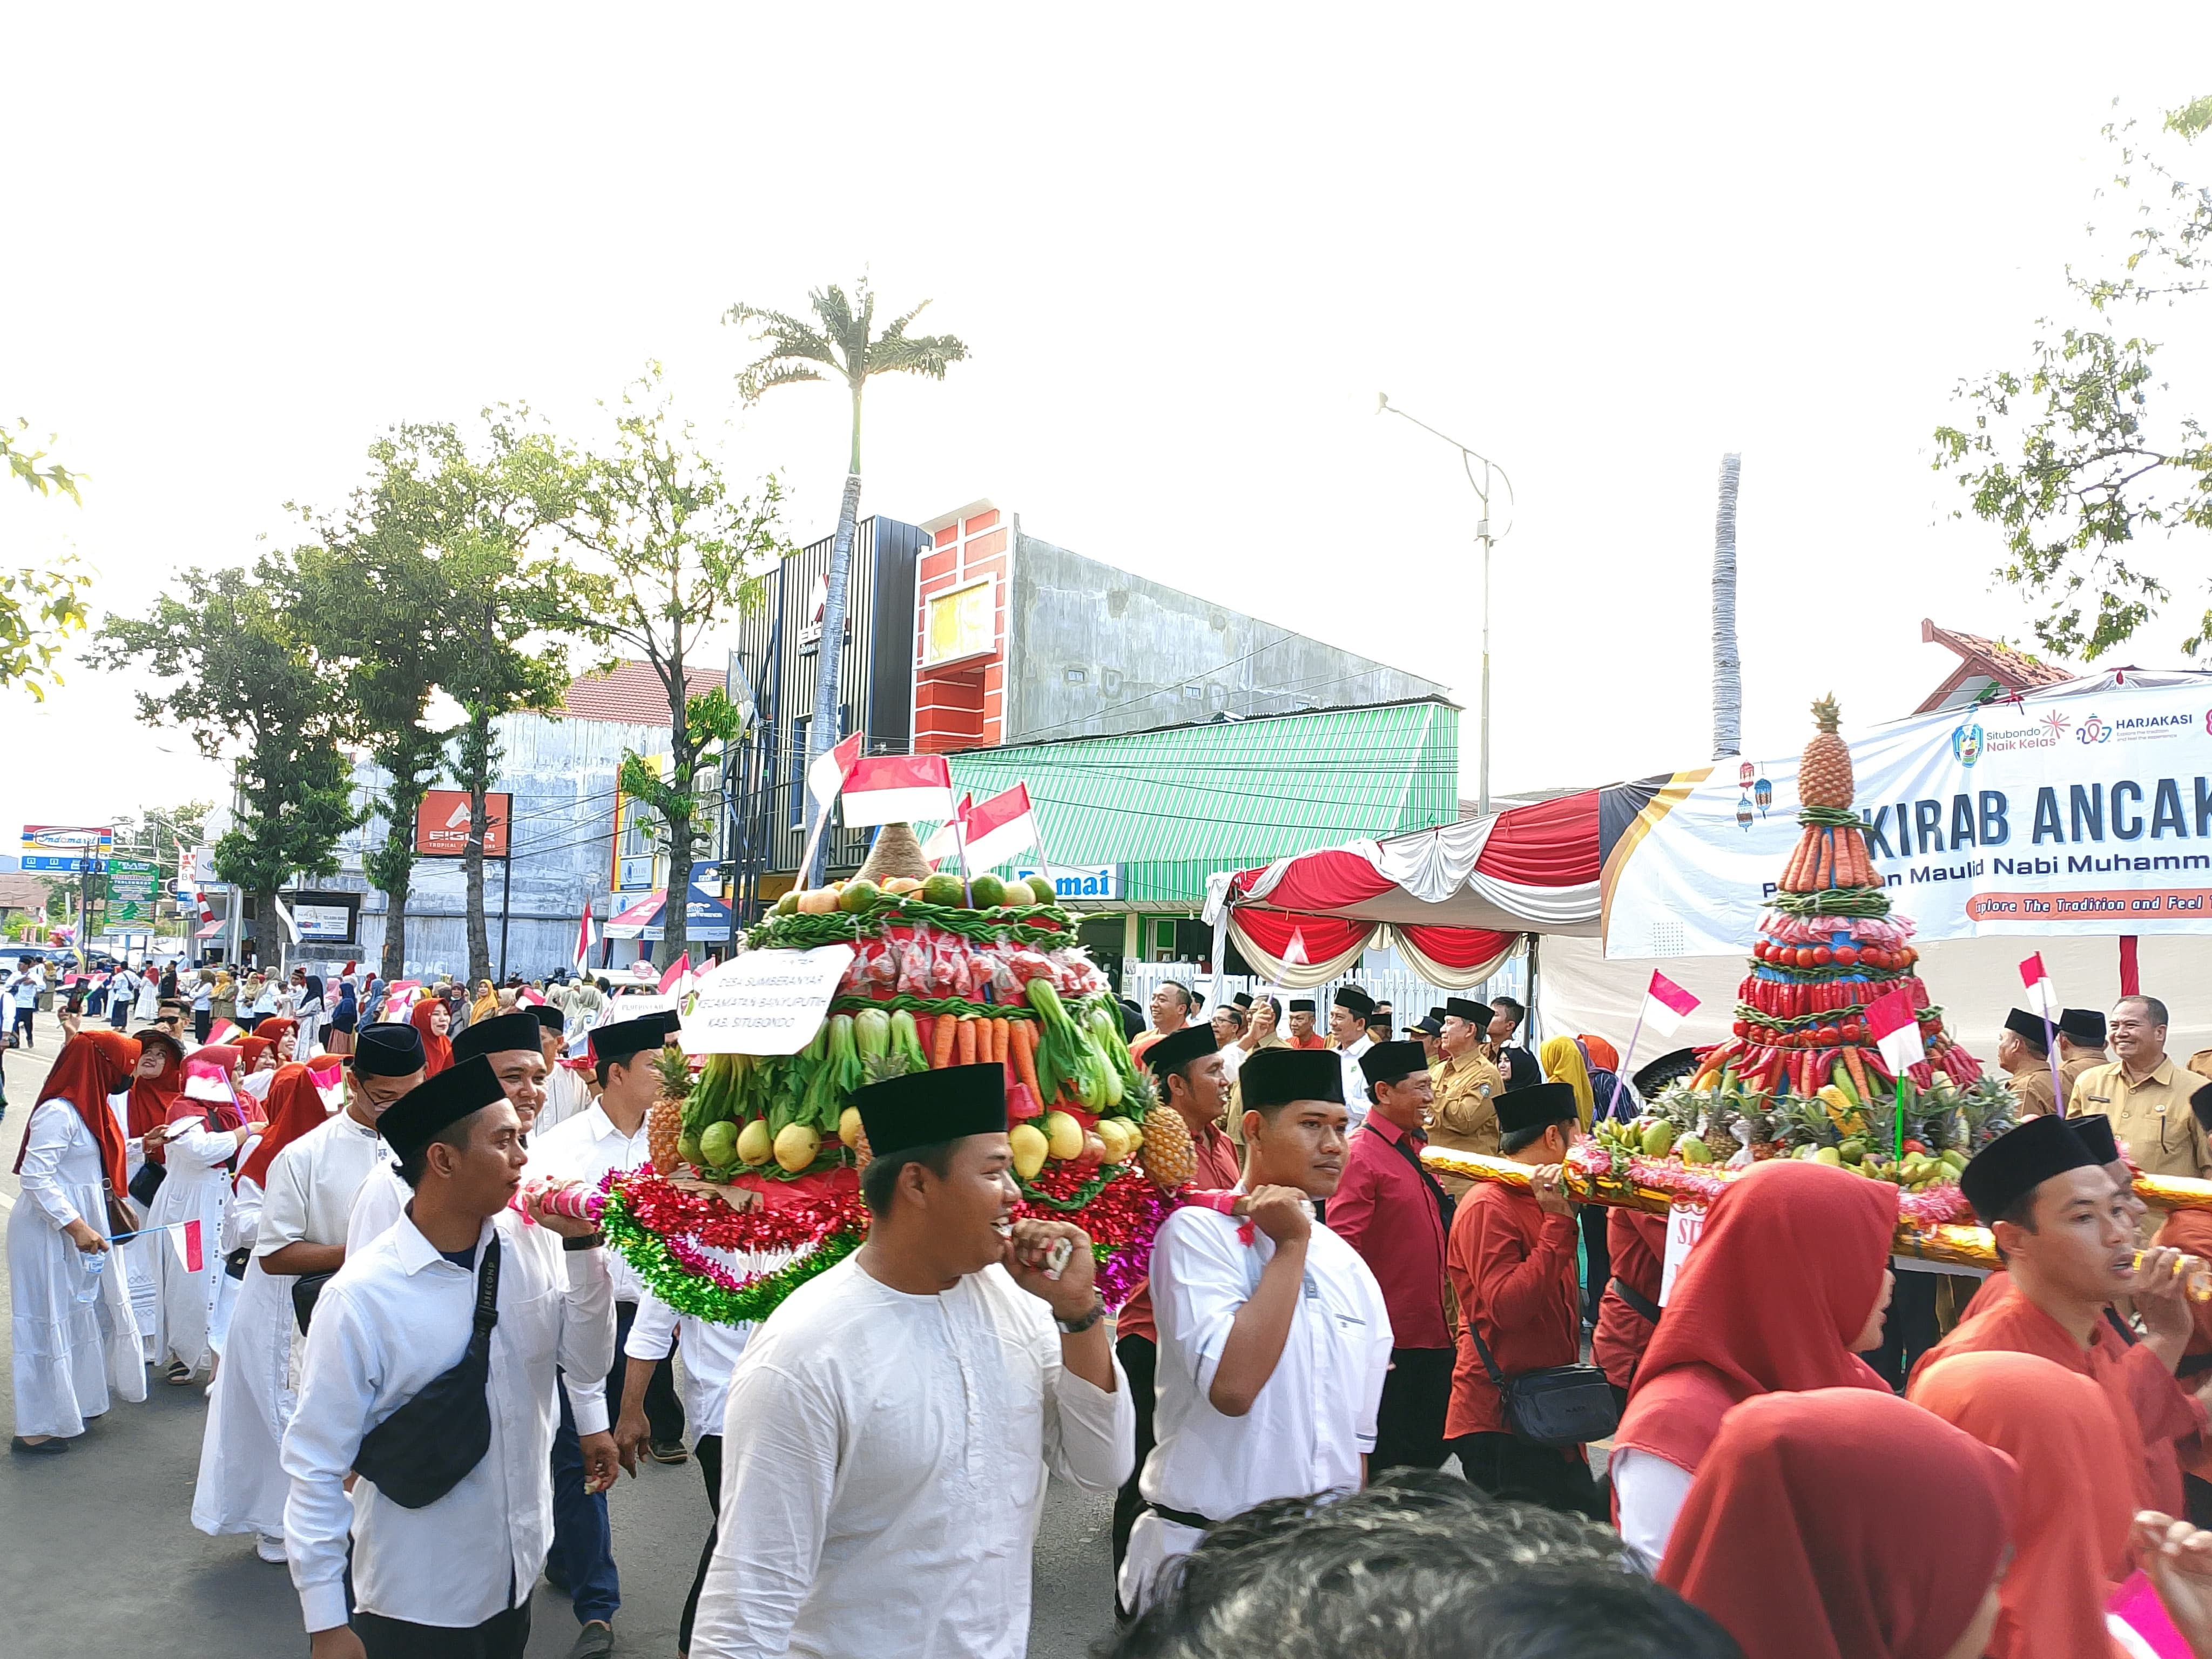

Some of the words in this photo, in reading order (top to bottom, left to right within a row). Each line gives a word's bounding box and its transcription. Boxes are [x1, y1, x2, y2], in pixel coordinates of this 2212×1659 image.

[2116, 714, 2193, 729] HARJAKASI
[1986, 727, 2041, 740] Situbondo
[1987, 740, 2017, 752] Naik
[2019, 738, 2056, 748] Kelas
[1862, 790, 2010, 860] KIRAB
[429, 831, 495, 842] EIGR
[1910, 859, 1984, 884] Maulid
[1993, 856, 2058, 875] Nabi
[2024, 899, 2051, 913] The
[2056, 898, 2126, 912] Tradition
[2131, 896, 2161, 911] and
[2167, 895, 2203, 910] Feel
